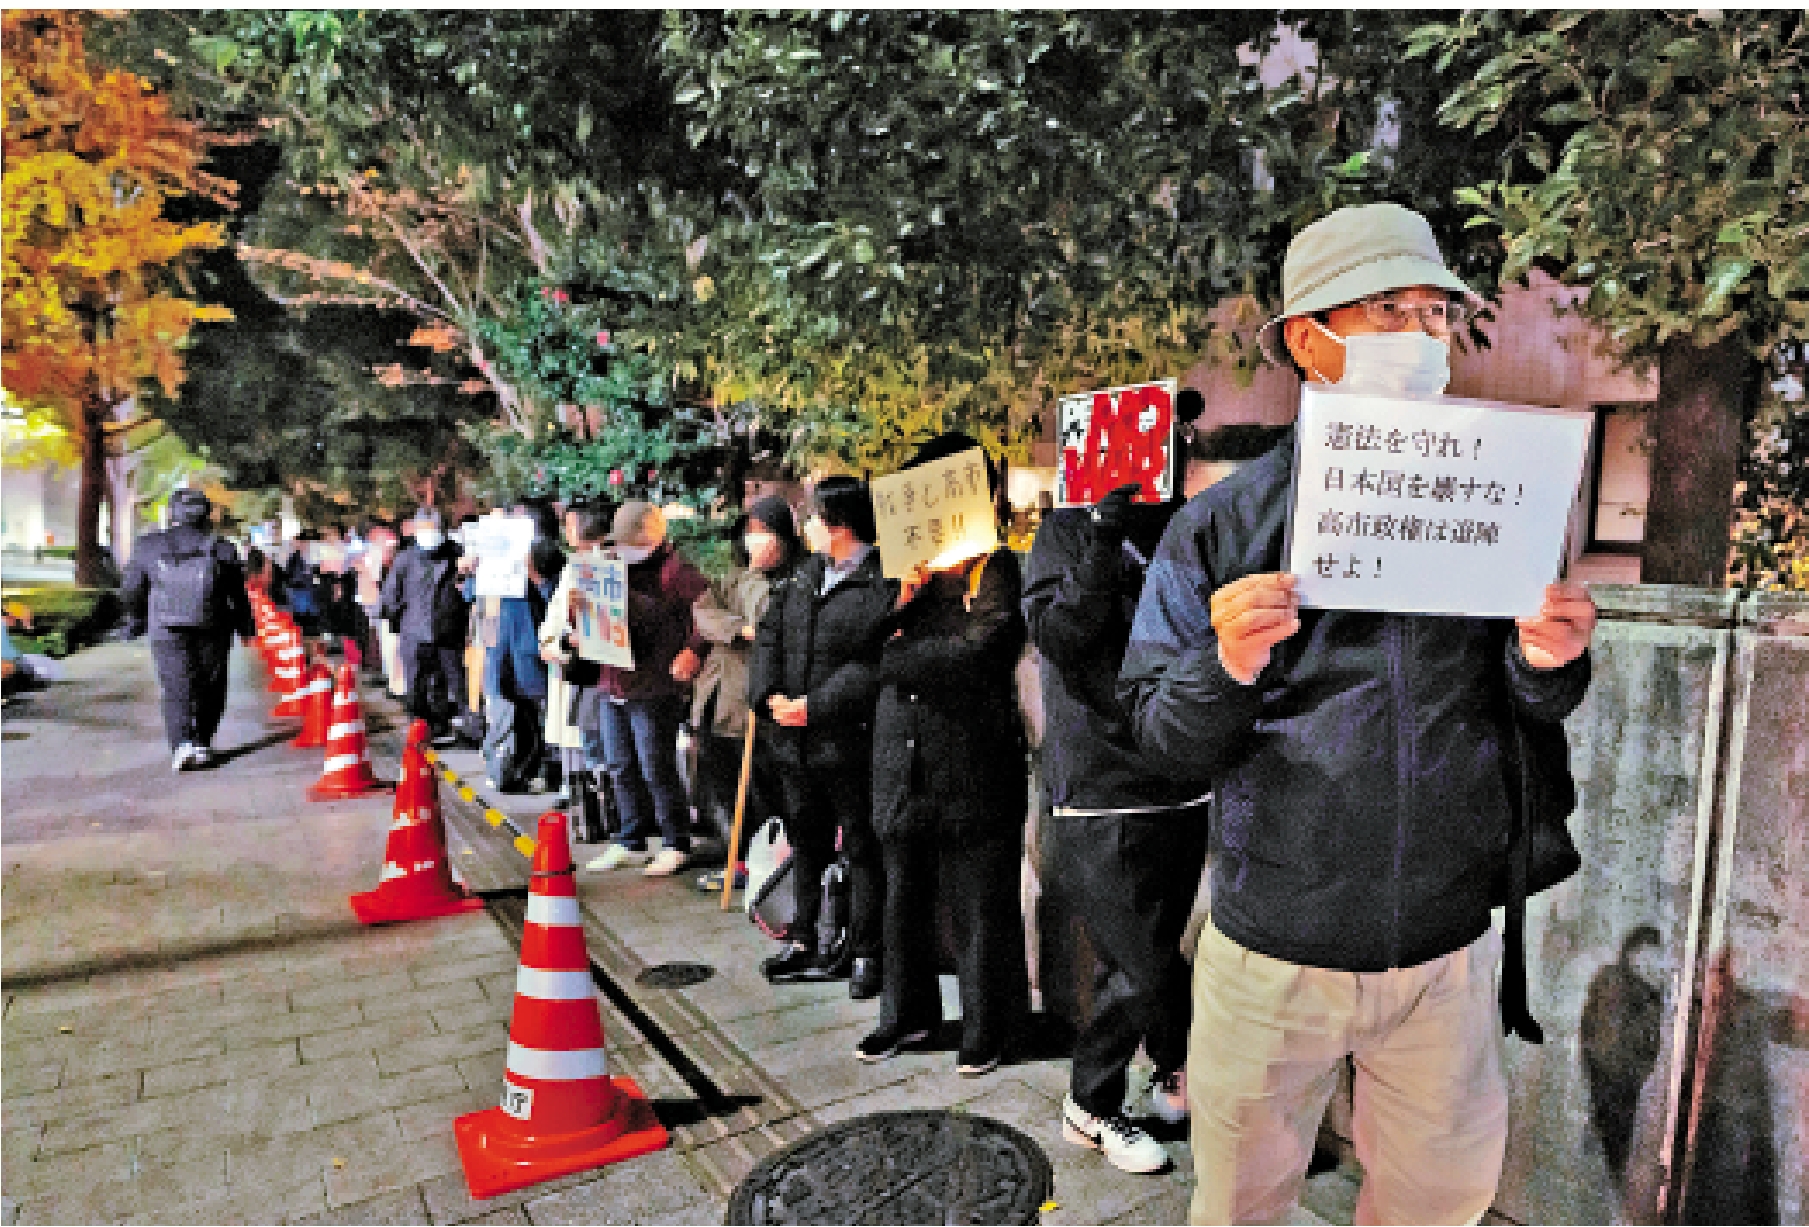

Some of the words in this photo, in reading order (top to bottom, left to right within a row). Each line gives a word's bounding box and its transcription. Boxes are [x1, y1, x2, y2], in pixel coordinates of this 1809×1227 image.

[1088, 384, 1172, 452] NO
[1325, 421, 1482, 460] 憲法を守れ！
[1324, 466, 1523, 505] 日本国を壊すな！
[1317, 508, 1502, 546] 高市政権は退陣
[1312, 553, 1382, 578] せよ！
